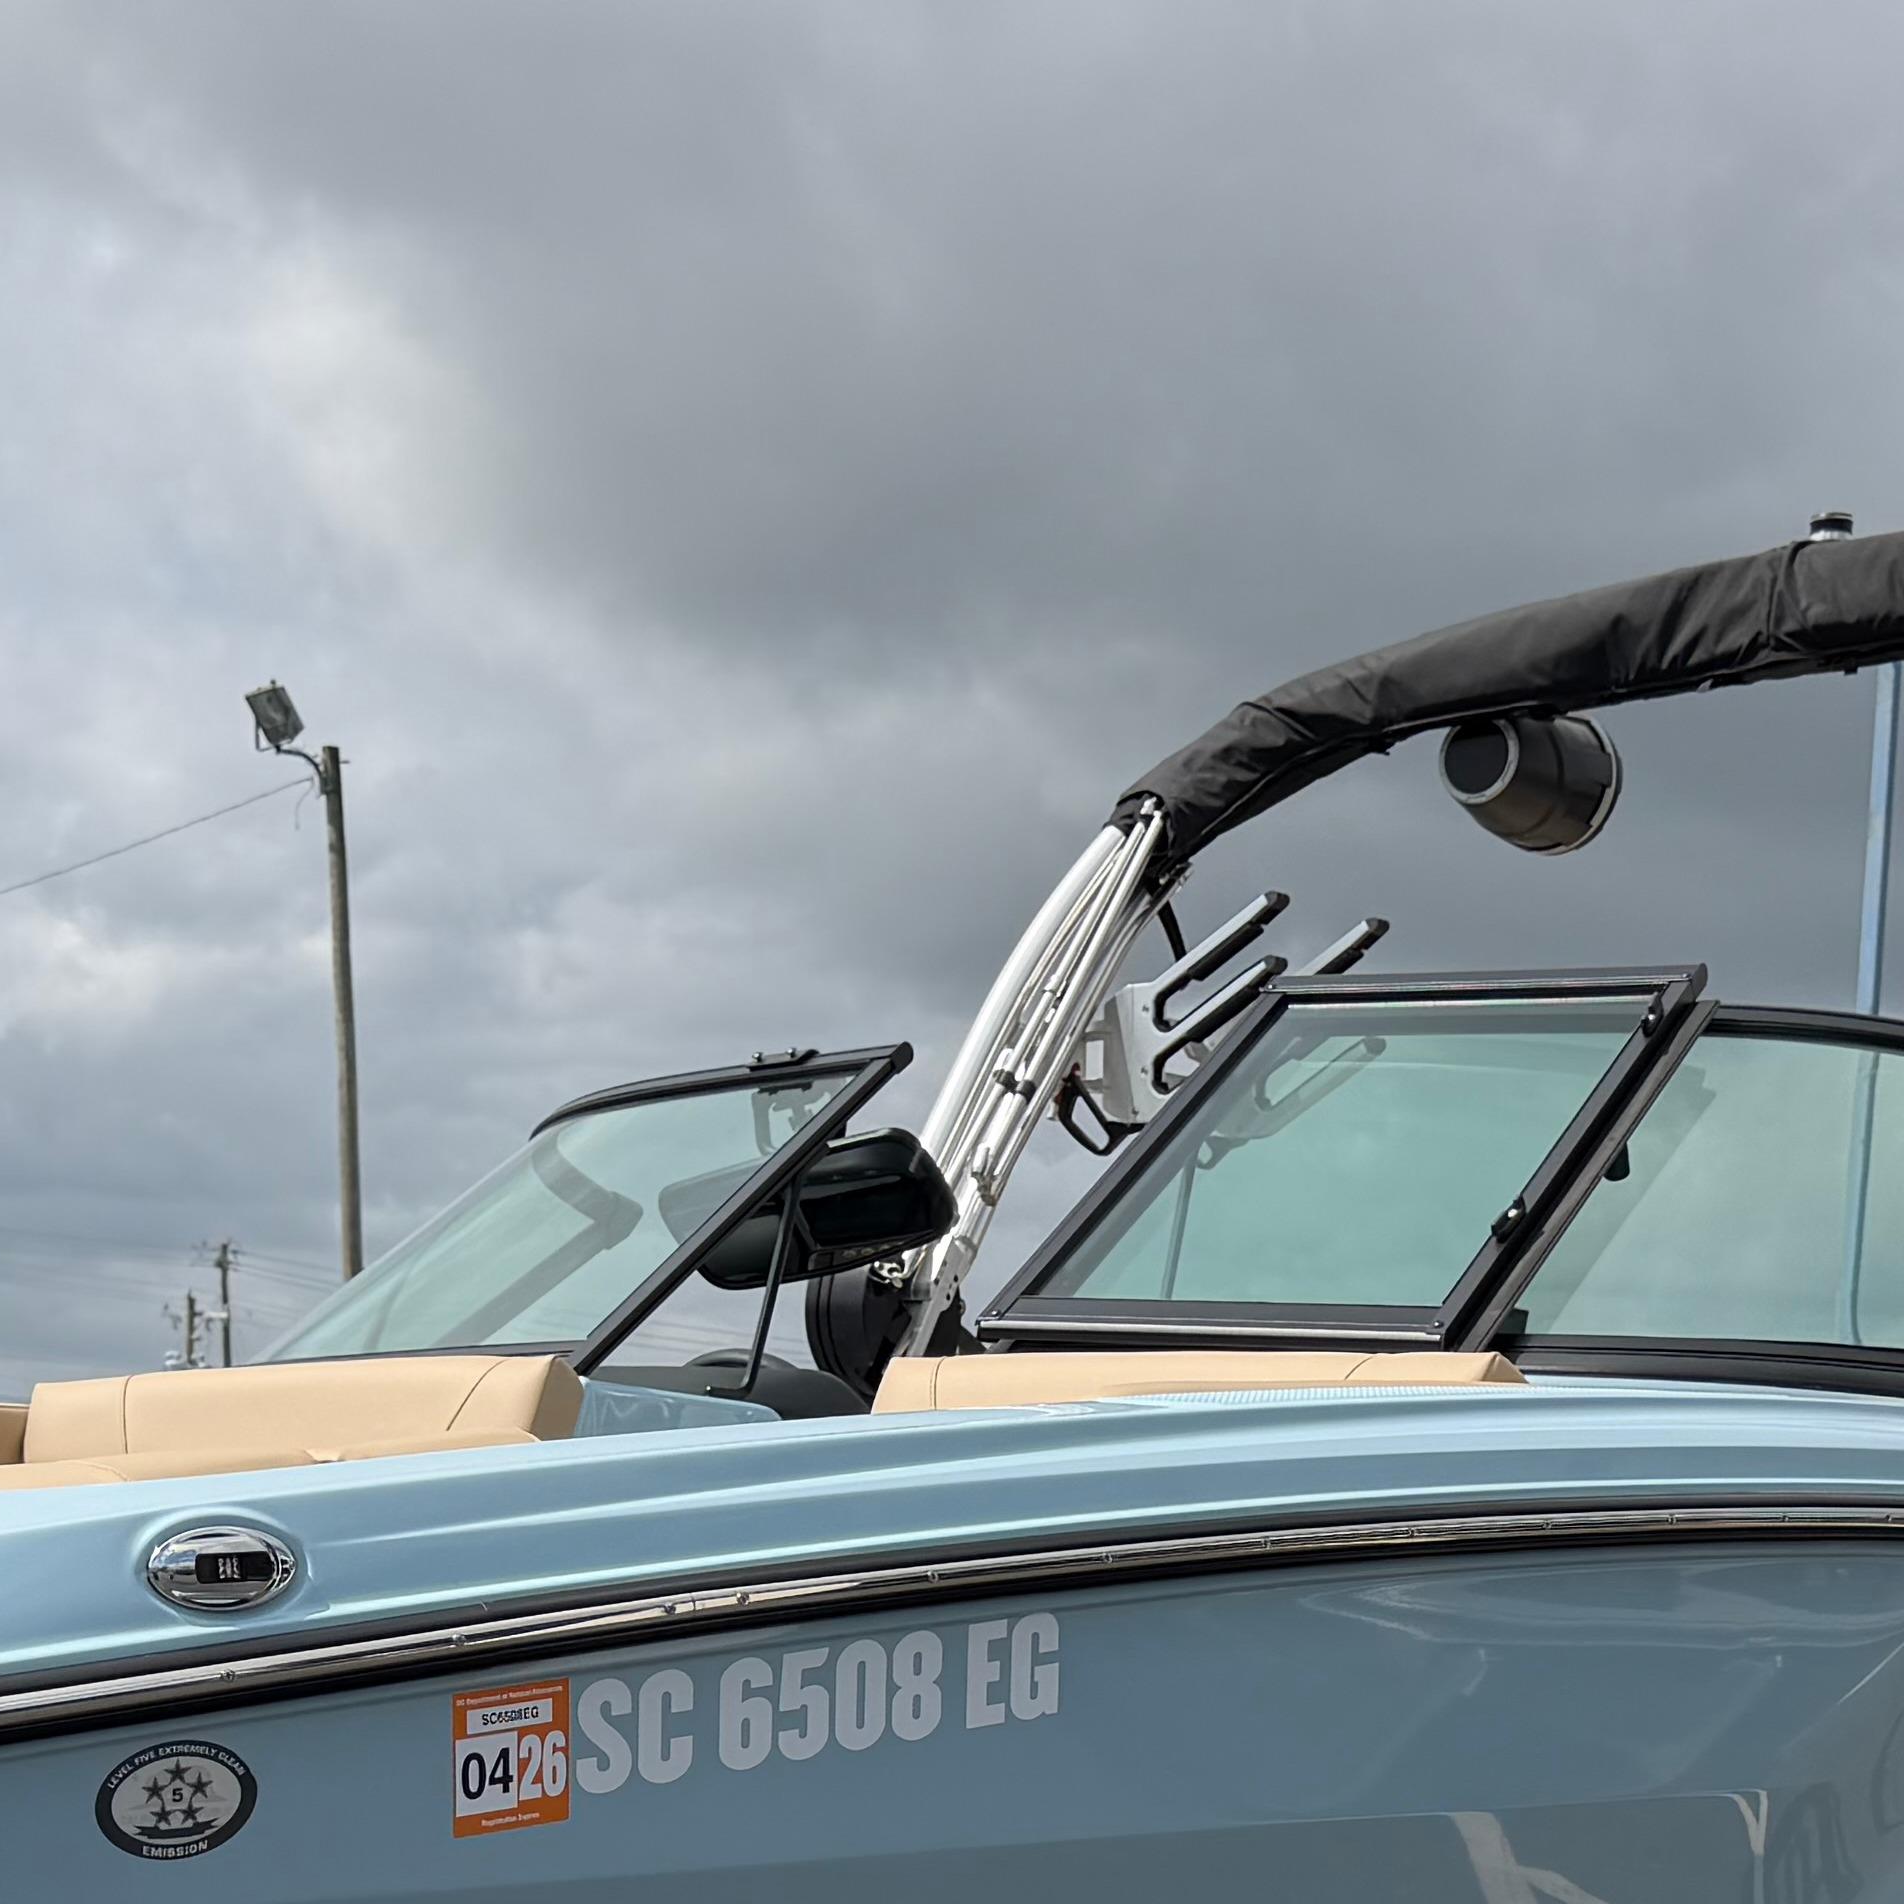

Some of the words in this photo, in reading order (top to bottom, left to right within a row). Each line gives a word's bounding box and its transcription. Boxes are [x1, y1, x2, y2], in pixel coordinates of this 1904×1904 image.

[575, 1669, 694, 1794] SC
[718, 1629, 943, 1771] 6508
[966, 1612, 1060, 1729] EG
[107, 1763, 133, 1789] LEVEL
[134, 1751, 156, 1767] FIVE
[158, 1744, 218, 1757] EXTREMELY
[218, 1752, 247, 1776] CLEAN
[461, 1747, 514, 1800] 04
[519, 1730, 567, 1801] 26
[171, 1787, 184, 1802] 5
[142, 1839, 208, 1859] EMISSION
